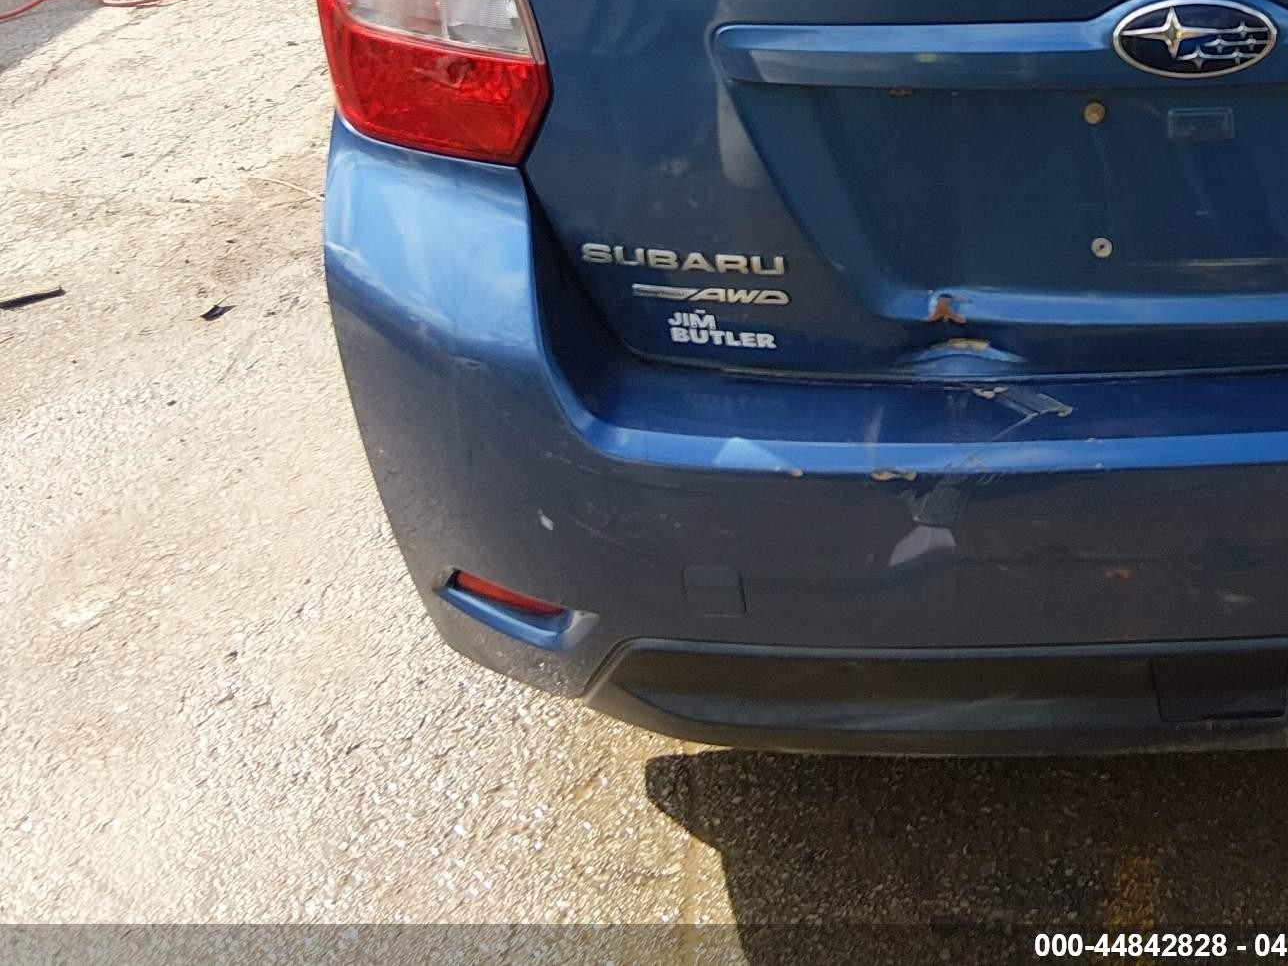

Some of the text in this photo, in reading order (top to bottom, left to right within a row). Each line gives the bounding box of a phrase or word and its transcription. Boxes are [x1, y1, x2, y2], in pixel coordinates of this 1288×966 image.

[581, 242, 785, 276] SUBARU
[688, 287, 789, 305] AWD
[667, 309, 717, 330] JIM
[670, 327, 777, 349] BUTLER
